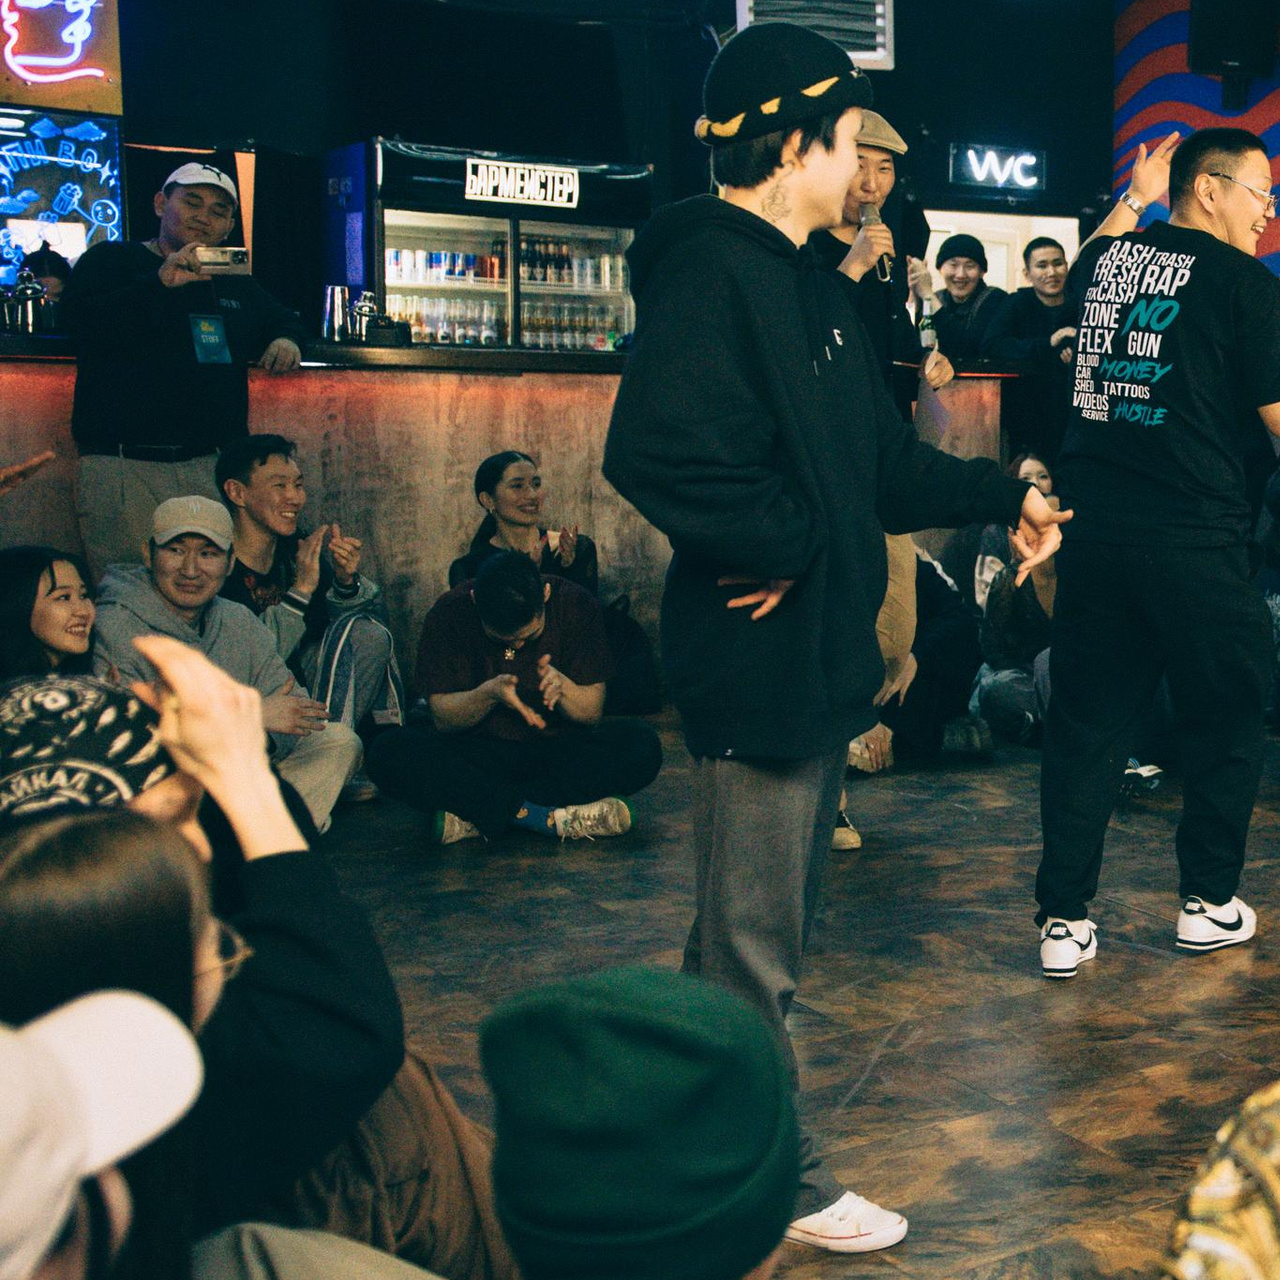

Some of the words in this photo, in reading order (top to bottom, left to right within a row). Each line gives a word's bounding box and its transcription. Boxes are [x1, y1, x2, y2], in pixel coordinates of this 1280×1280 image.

[968, 150, 1037, 186] WC
[1151, 252, 1195, 269] TRASH
[1092, 260, 1144, 284] FRESH
[1140, 264, 1190, 296] RAP
[1097, 281, 1138, 304] CASH
[1082, 302, 1121, 328] ZONE
[1121, 293, 1180, 336] NO
[1078, 328, 1115, 354] FLEX
[1127, 331, 1162, 358] GUN
[1075, 367, 1091, 379] CAR
[1077, 354, 1099, 367] BLOOD
[1099, 356, 1174, 383] MONEY
[1072, 392, 1109, 411] VIDEOS
[1074, 379, 1094, 392] SHED
[1102, 381, 1150, 399] TATTOOS
[1081, 410, 1109, 422] SERVICE
[1113, 401, 1168, 427] HUSTLE
[0, 769, 90, 812] АЙКАЛ
